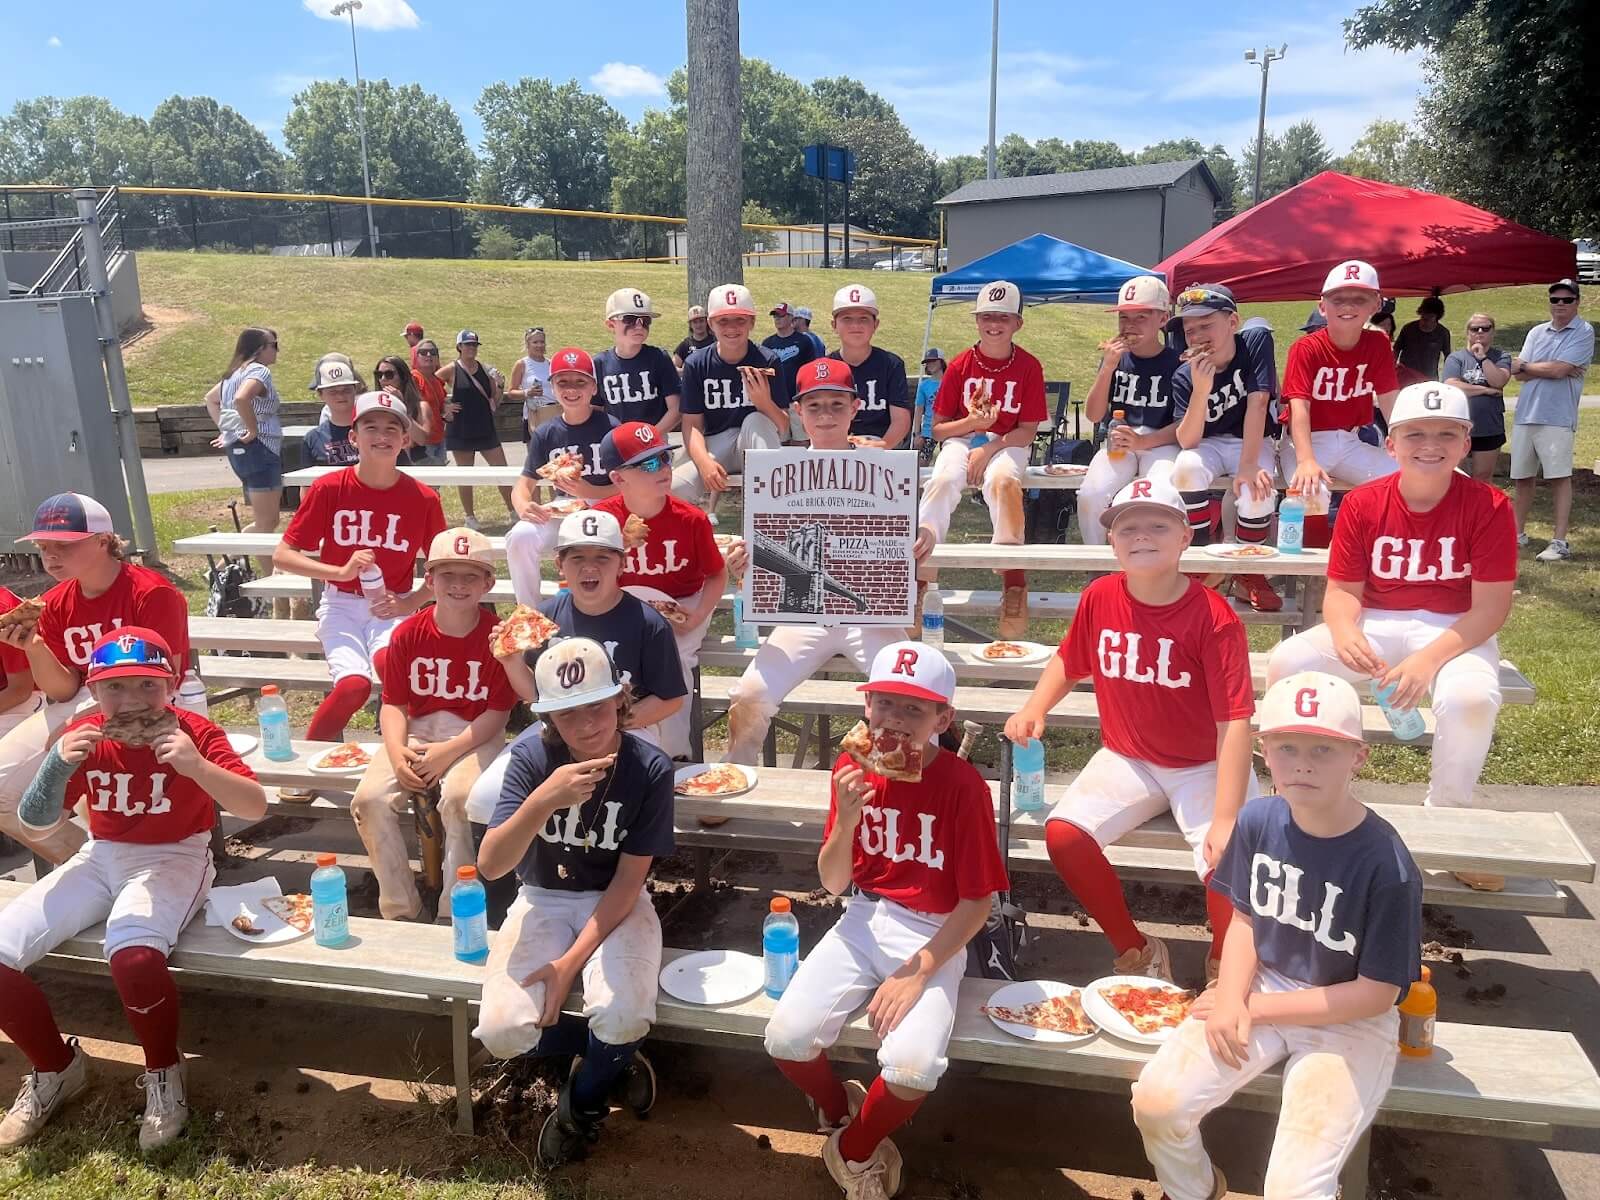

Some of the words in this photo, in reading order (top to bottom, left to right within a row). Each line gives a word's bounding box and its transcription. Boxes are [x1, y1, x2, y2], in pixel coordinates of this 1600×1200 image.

[1344, 264, 1360, 280] R
[633, 294, 643, 308] G
[726, 290, 736, 305] G
[850, 289, 860, 303] G
[989, 287, 1006, 302] W
[1125, 285, 1136, 301] G
[328, 367, 343, 380] W
[815, 362, 829, 380] B
[603, 371, 658, 405] GLL
[1112, 370, 1168, 408] GLL
[1312, 363, 1374, 402] GLL
[378, 392, 393, 408] G
[1206, 368, 1248, 422] GLL
[1424, 389, 1442, 411] G
[635, 424, 654, 443] W
[770, 458, 894, 501] GRIMALDI'S
[1130, 480, 1152, 499] R
[805, 497, 845, 507] BRICK-OVEN
[847, 498, 876, 508] PIZZERIA
[332, 509, 409, 552] GLL
[582, 516, 599, 536] G
[454, 536, 471, 555] G
[839, 538, 869, 549] PIZZA
[879, 539, 898, 547] MADE
[876, 547, 905, 559] FAMOUS
[1371, 535, 1472, 582] GLL
[891, 648, 919, 677] R
[1097, 628, 1191, 689] GLL
[408, 656, 488, 701] GLL
[556, 656, 586, 690] W
[1294, 687, 1320, 718] G
[86, 769, 172, 817] GLL
[859, 805, 945, 871] GLL
[1249, 852, 1358, 957] GLL
